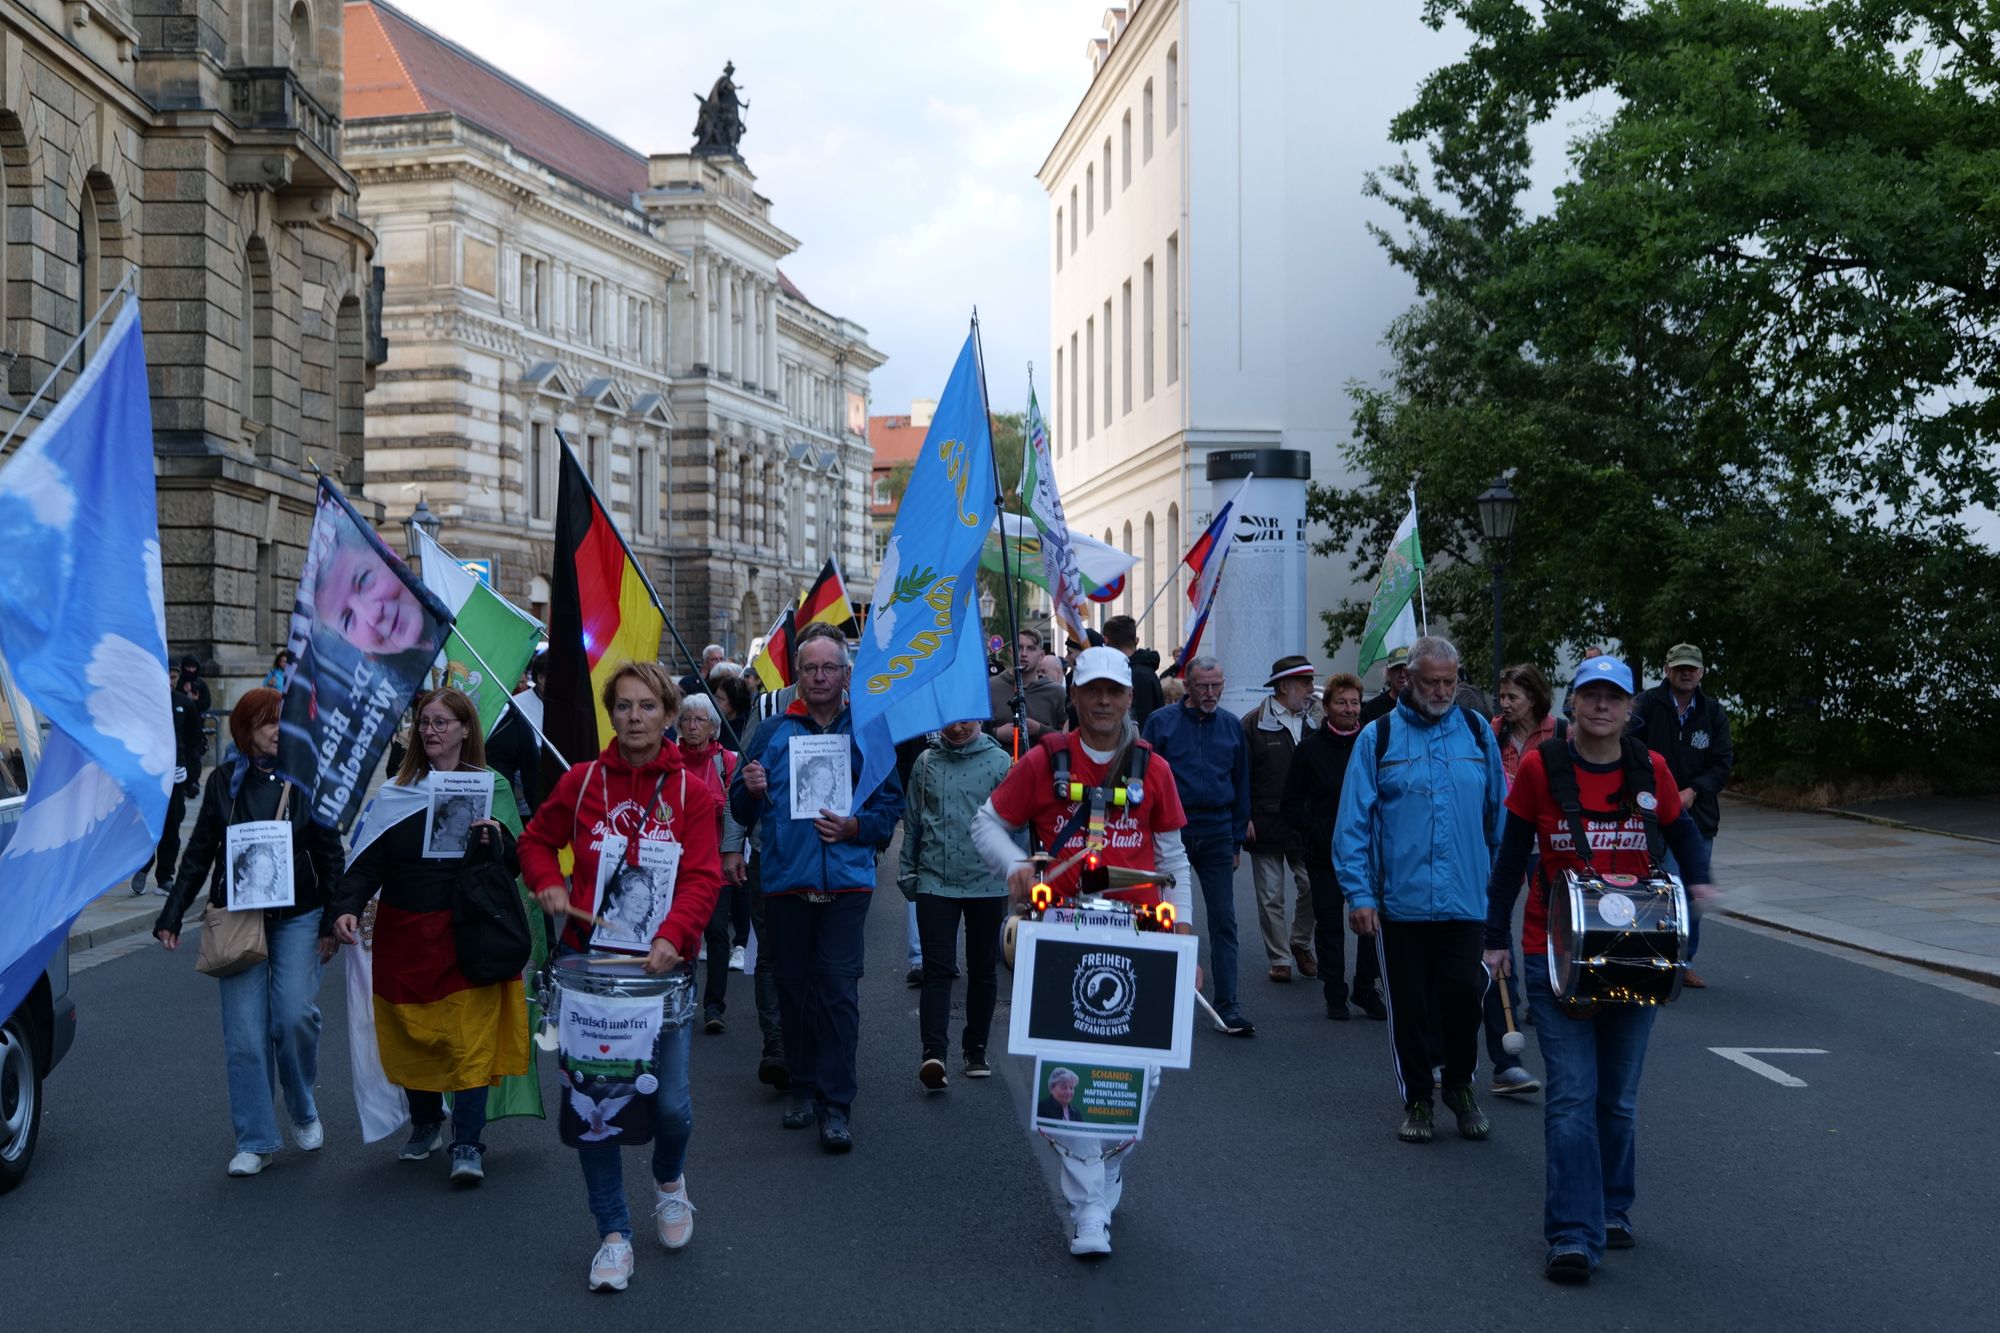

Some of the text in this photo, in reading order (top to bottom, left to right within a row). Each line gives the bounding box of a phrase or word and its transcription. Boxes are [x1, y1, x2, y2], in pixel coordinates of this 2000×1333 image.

[1230, 452, 1257, 460] STRÖER
[648, 825, 670, 841] das
[1112, 831, 1143, 848] laut!
[1089, 914, 1108, 926] und
[1082, 953, 1132, 971] FREIHEIT
[569, 1011, 648, 1030] Deutsch und frei
[1085, 1015, 1097, 1024] ALLE
[1097, 1014, 1130, 1025] POLITISCHEN
[1073, 1019, 1130, 1036] GEFANGENEN
[1090, 1069, 1133, 1081] SCHANDE:
[1092, 1080, 1128, 1090] VORZEITIGE
[1084, 1088, 1137, 1099] HAFTENTLASSUNG
[1082, 1097, 1095, 1105] VON
[1106, 1099, 1137, 1108] WITZSCHEL
[1087, 1106, 1133, 1117] ABGELEHNT!
